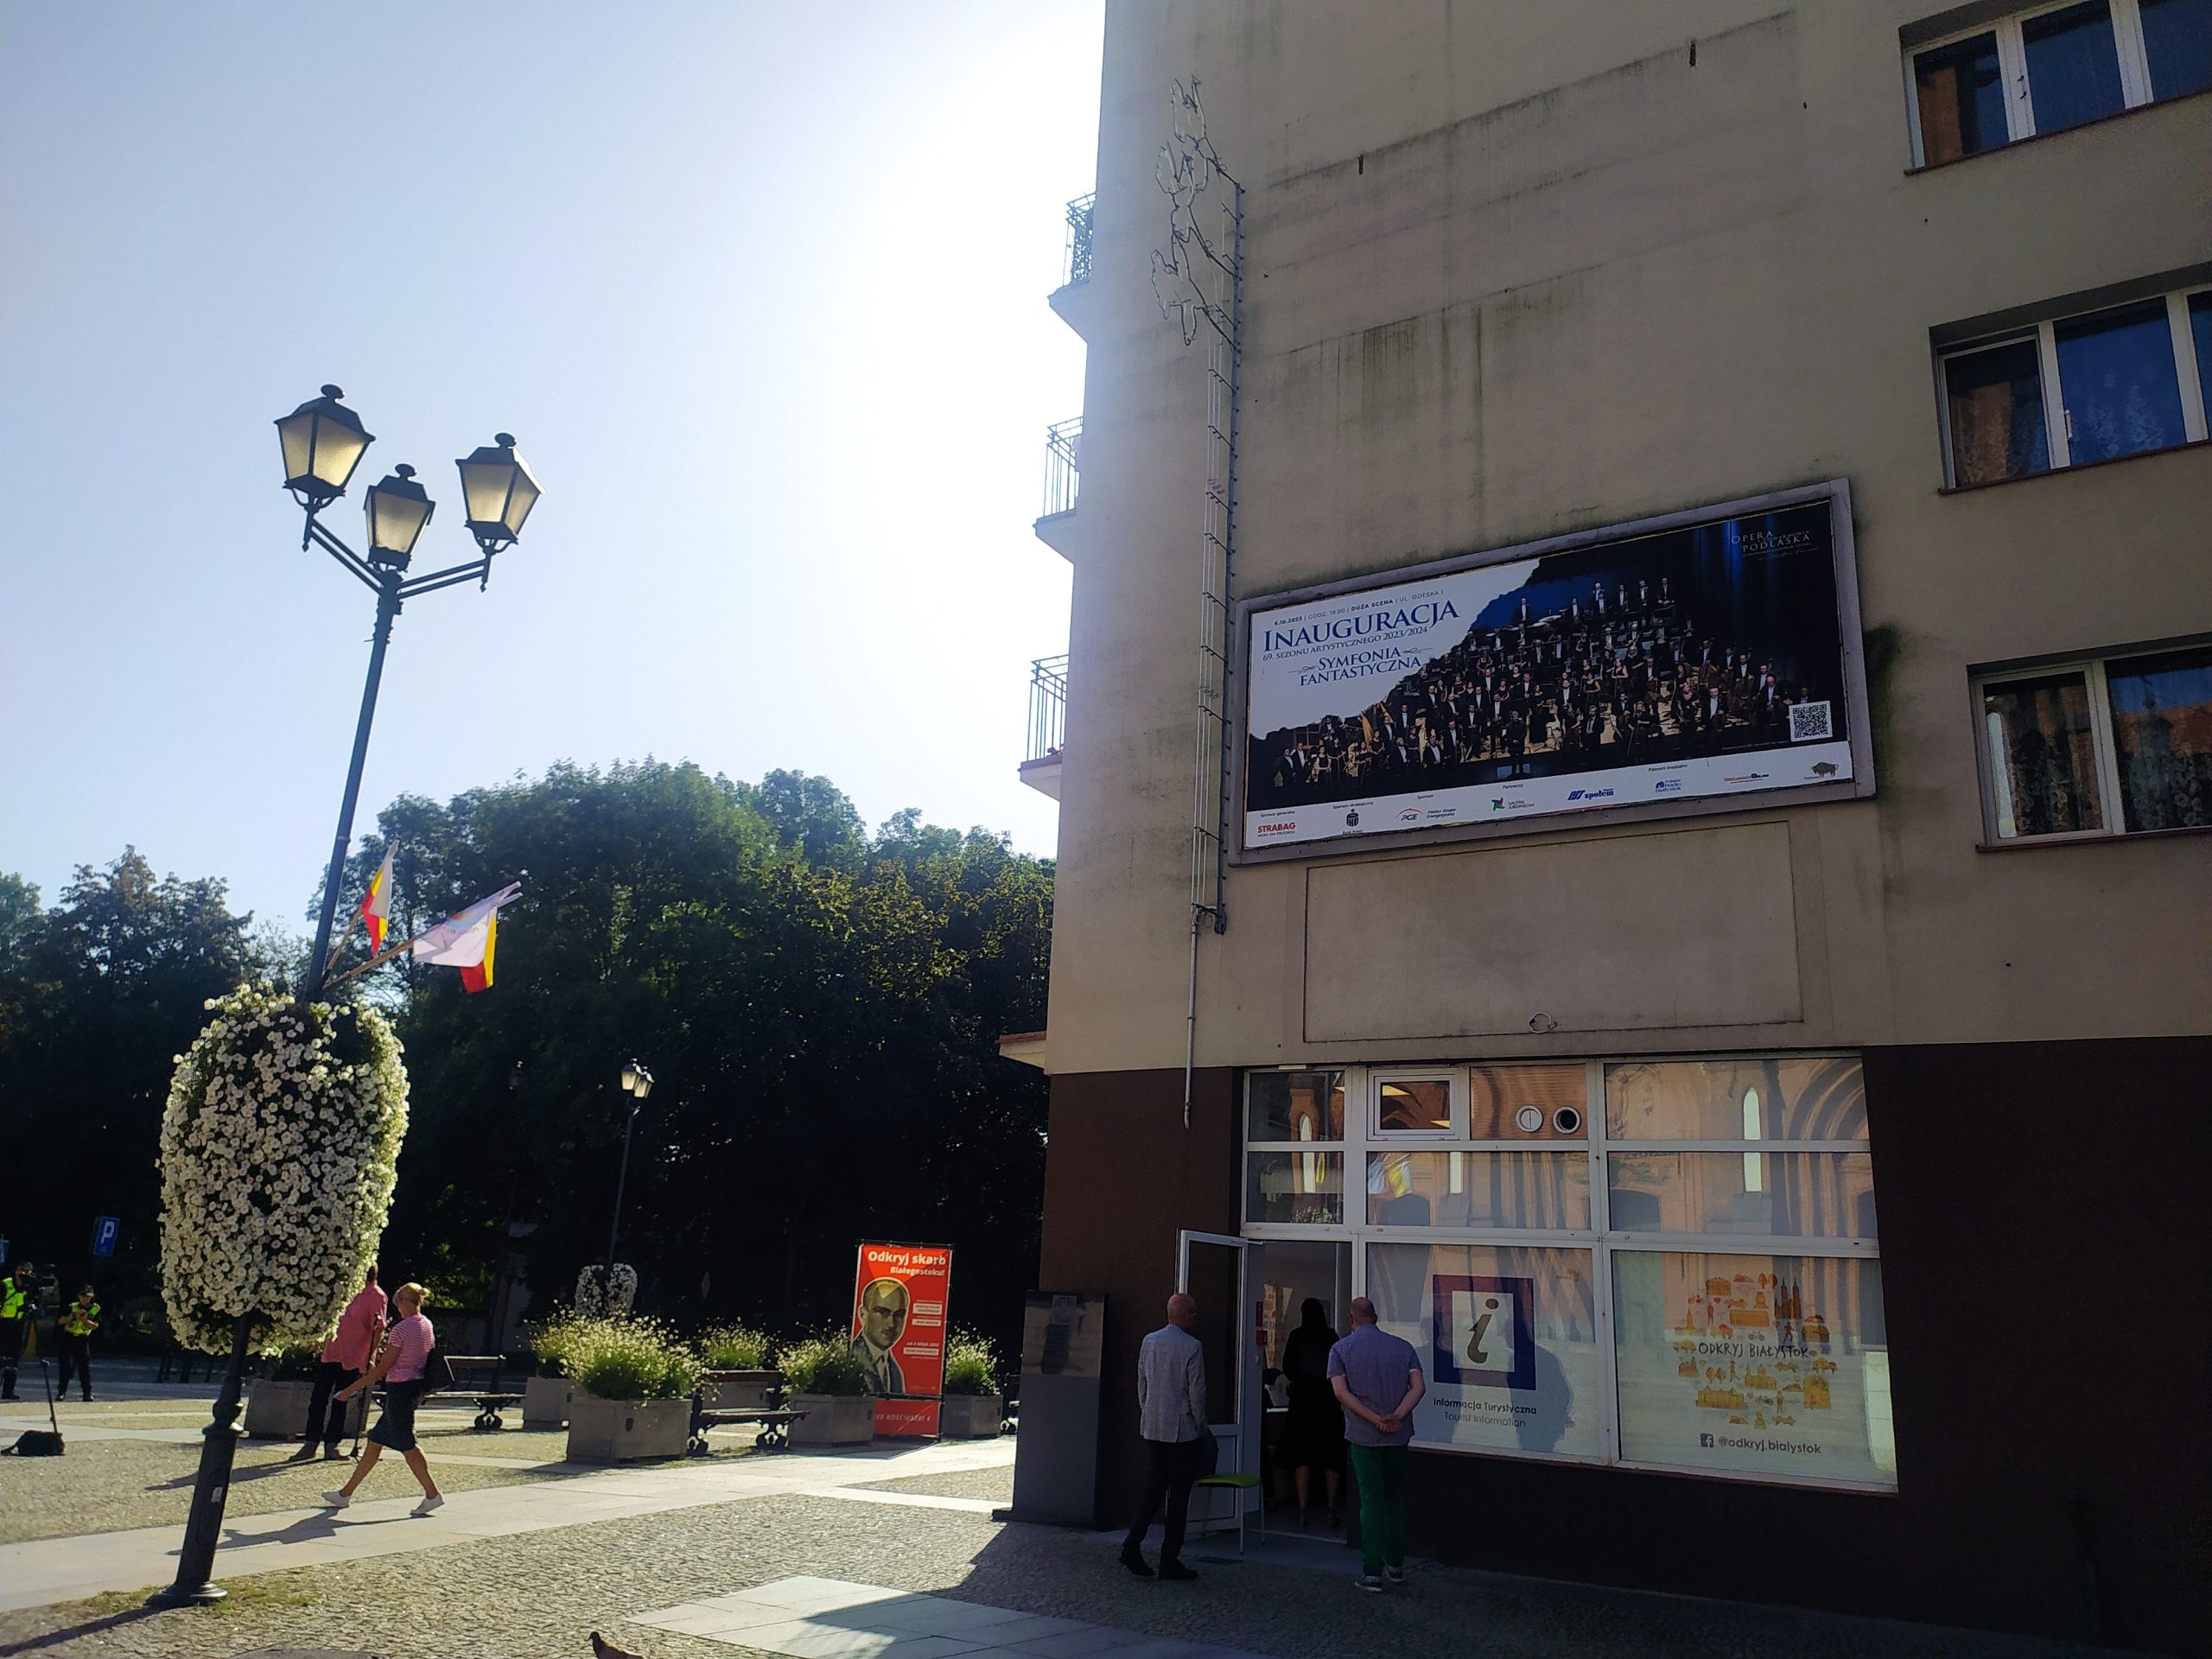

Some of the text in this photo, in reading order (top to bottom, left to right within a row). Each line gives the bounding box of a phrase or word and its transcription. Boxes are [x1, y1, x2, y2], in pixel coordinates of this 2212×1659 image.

[1731, 531, 1773, 544] OPERA
[1743, 534, 1810, 553] PODLASKA
[1274, 616, 1302, 626] 6.10.2023
[1351, 602, 1370, 612] DUŻA
[1371, 599, 1394, 608] SCENA
[1262, 600, 1460, 652] INAUGURACJA
[1262, 626, 1428, 662] 69. SEZONU ARTYSTYCZNEGO 2023/2024
[1318, 646, 1402, 671] SYMFONIA
[1300, 656, 1422, 686] FANTASTYCZNA
[1257, 822, 1296, 833] STRABAG
[100, 1221, 115, 1244] P
[868, 1250, 946, 1266] Odkryj skarb
[890, 1266, 945, 1276] Białegostoku!
[1698, 1342, 1744, 1357] ODKRYJ
[1749, 1344, 1809, 1358] BIAŁYSTOK
[1433, 1398, 1537, 1414] Informacja Turystyczna
[1445, 1412, 1526, 1427] Tourist Information
[1719, 1436, 1822, 1454] @odkryj.bialystok
